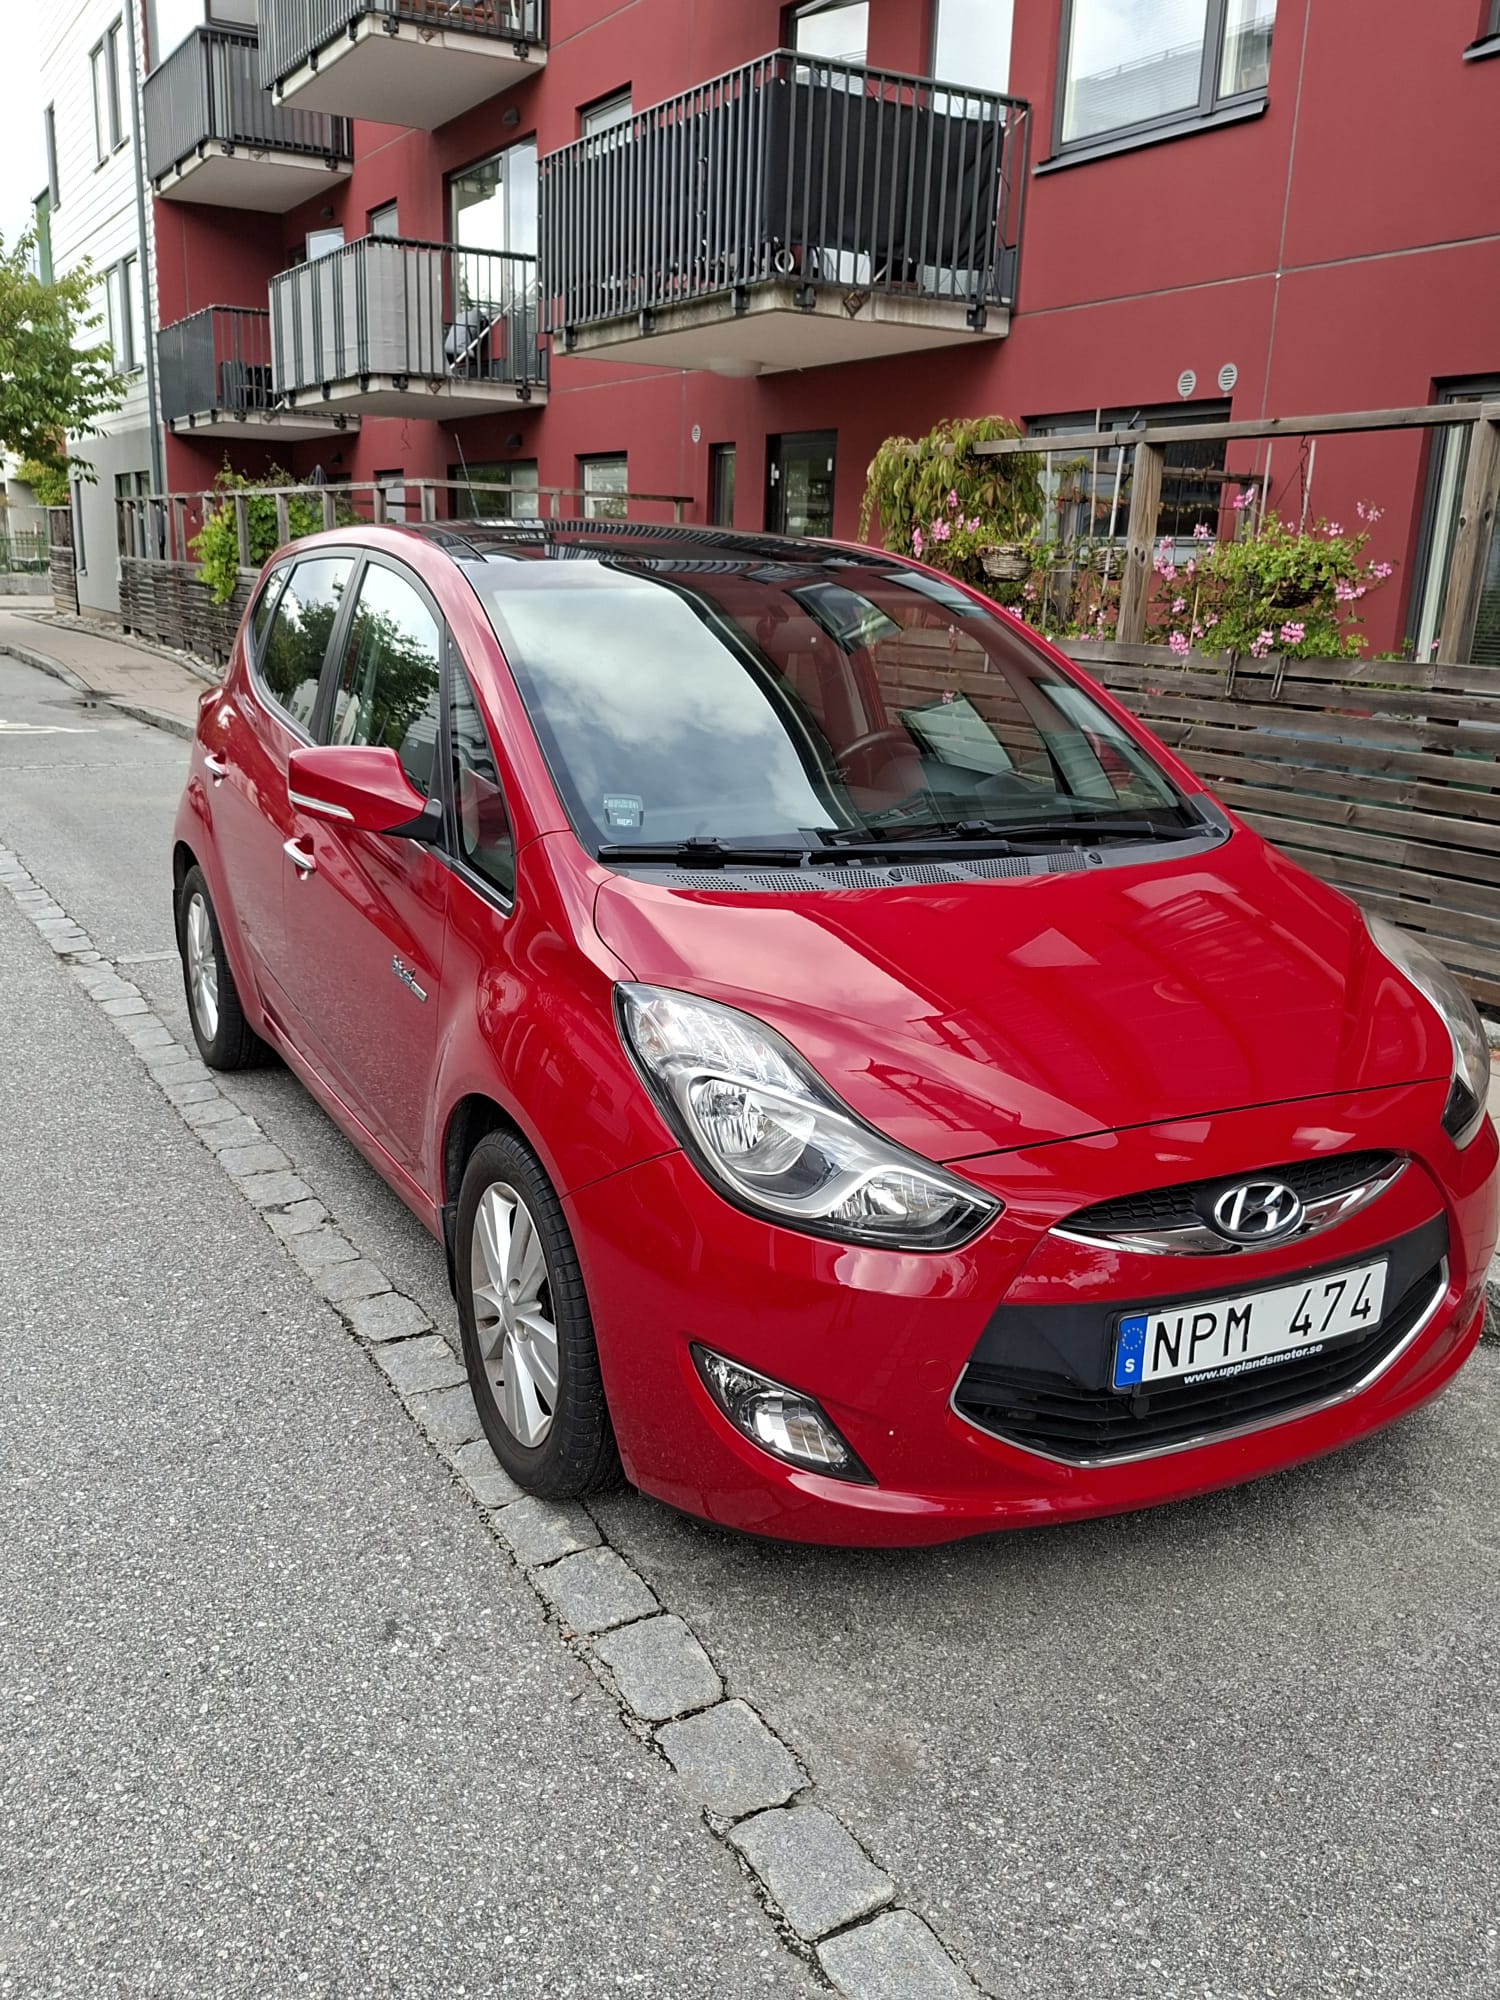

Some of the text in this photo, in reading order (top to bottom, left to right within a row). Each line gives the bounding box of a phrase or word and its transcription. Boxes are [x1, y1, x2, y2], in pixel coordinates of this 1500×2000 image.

[1152, 1273, 1372, 1372] NPM 474
[1124, 1358, 1136, 1373] S
[1183, 1343, 1324, 1385] www.upplandsmotor.se
